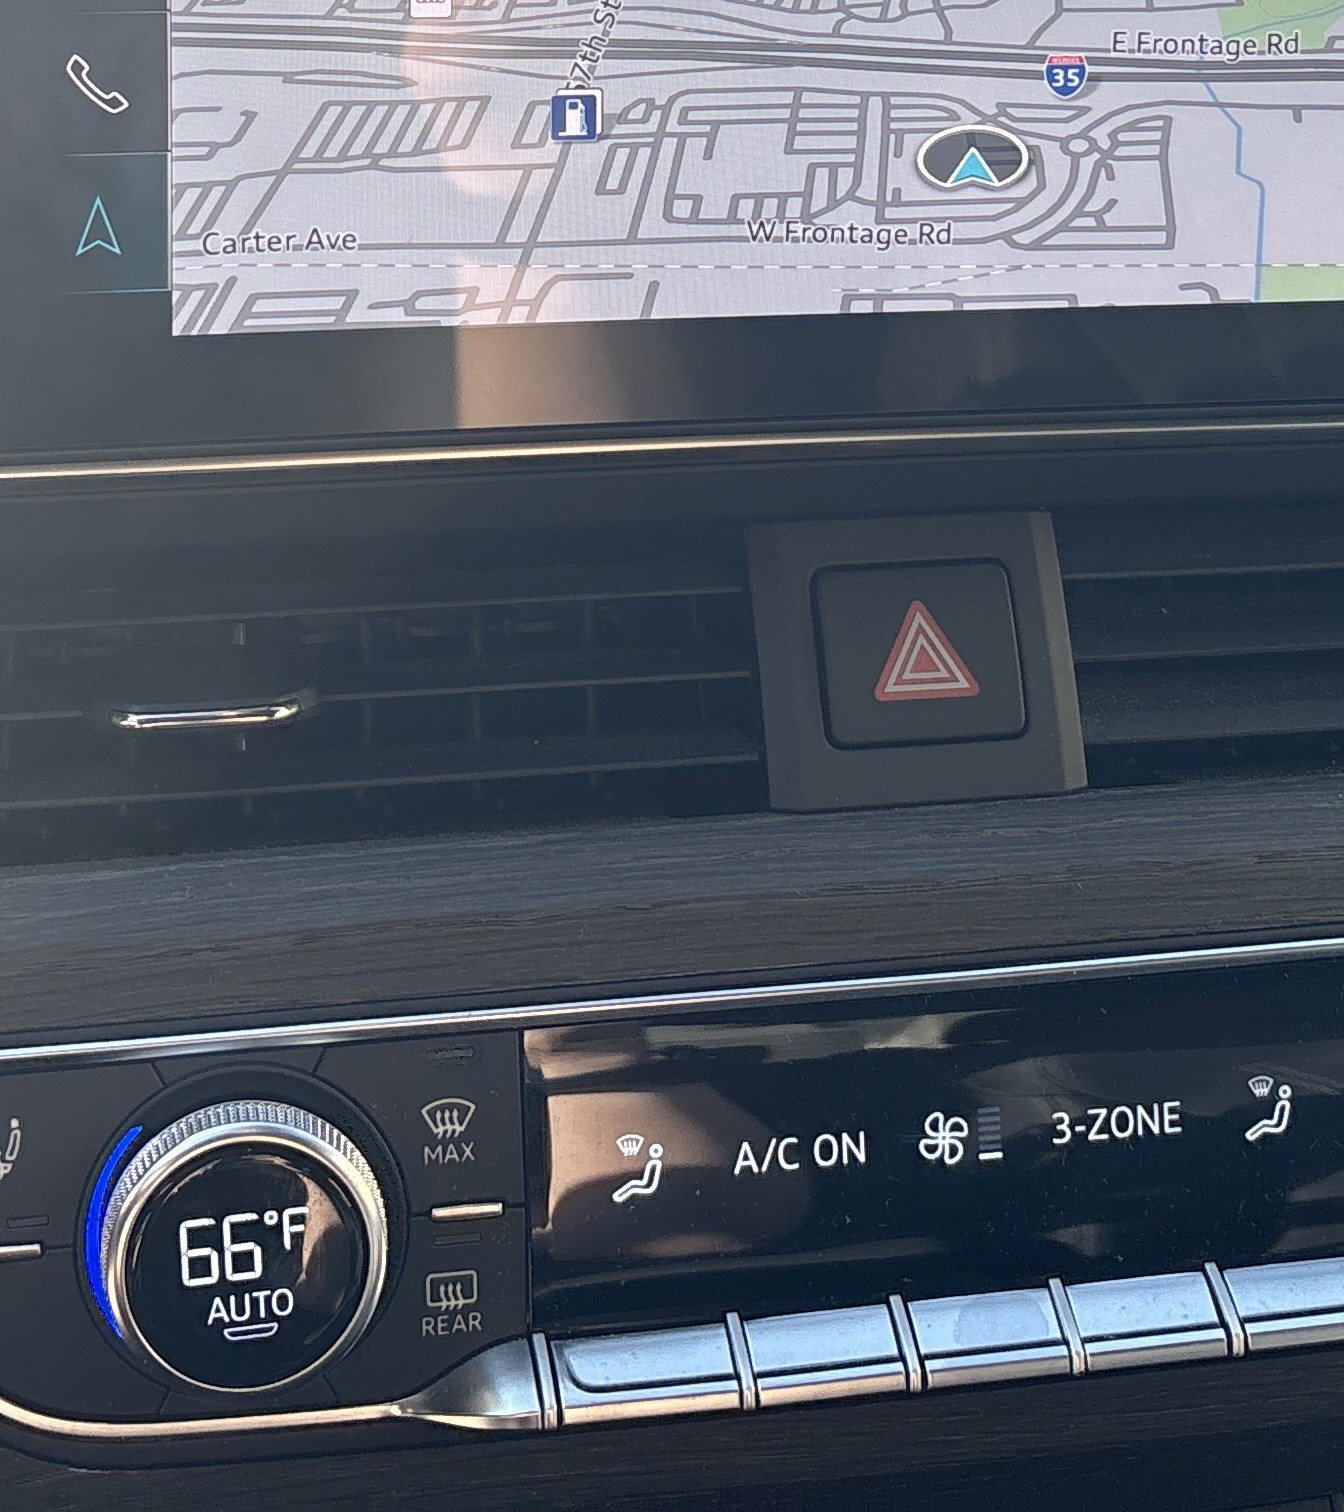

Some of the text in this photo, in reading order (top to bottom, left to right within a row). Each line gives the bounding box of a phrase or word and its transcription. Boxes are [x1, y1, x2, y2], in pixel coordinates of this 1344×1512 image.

[1112, 31, 1300, 62] E Frontage Rd
[1051, 68, 1080, 87] 35
[202, 227, 357, 256] Carter Ave
[747, 219, 952, 251] W Frontage Rd
[1051, 1100, 1183, 1145] 3-ZONE
[423, 1140, 476, 1166] MAX
[733, 1131, 867, 1176] A/C ON
[207, 1287, 294, 1326] AUTO
[421, 1310, 483, 1338] REAR
